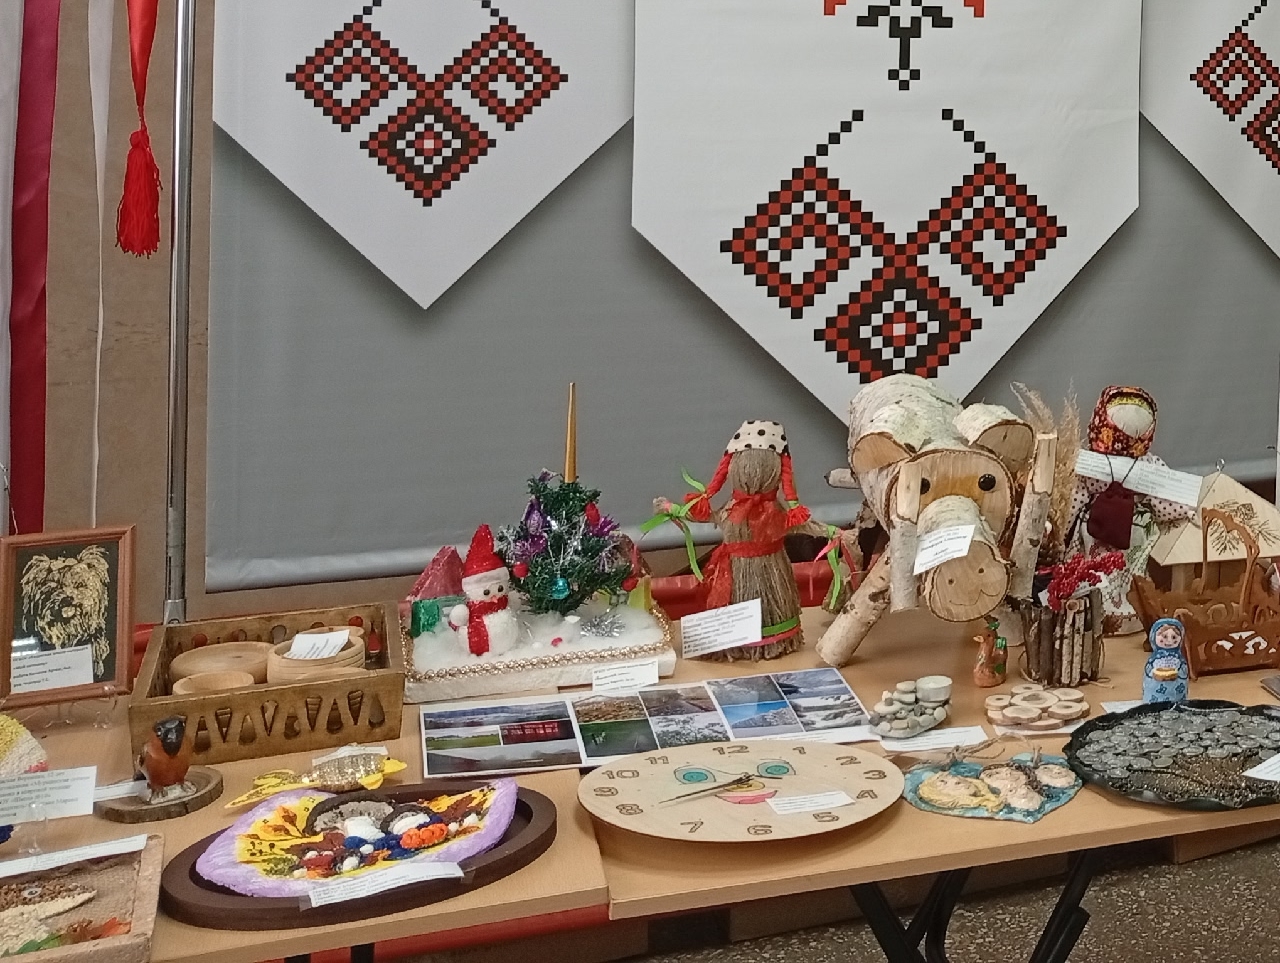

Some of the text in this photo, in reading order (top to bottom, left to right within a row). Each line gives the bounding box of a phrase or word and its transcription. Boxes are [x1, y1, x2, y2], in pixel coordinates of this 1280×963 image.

[712, 744, 750, 755] 12
[792, 746, 806, 755] 1
[644, 755, 670, 765] 11
[835, 755, 861, 766] 2
[601, 769, 640, 780] 10
[862, 769, 887, 780] 3
[593, 786, 619, 797] 9
[856, 789, 878, 800] 4
[615, 804, 643, 816] 8
[812, 811, 840, 823] 5
[680, 820, 704, 833] 7
[747, 824, 773, 836] 6
